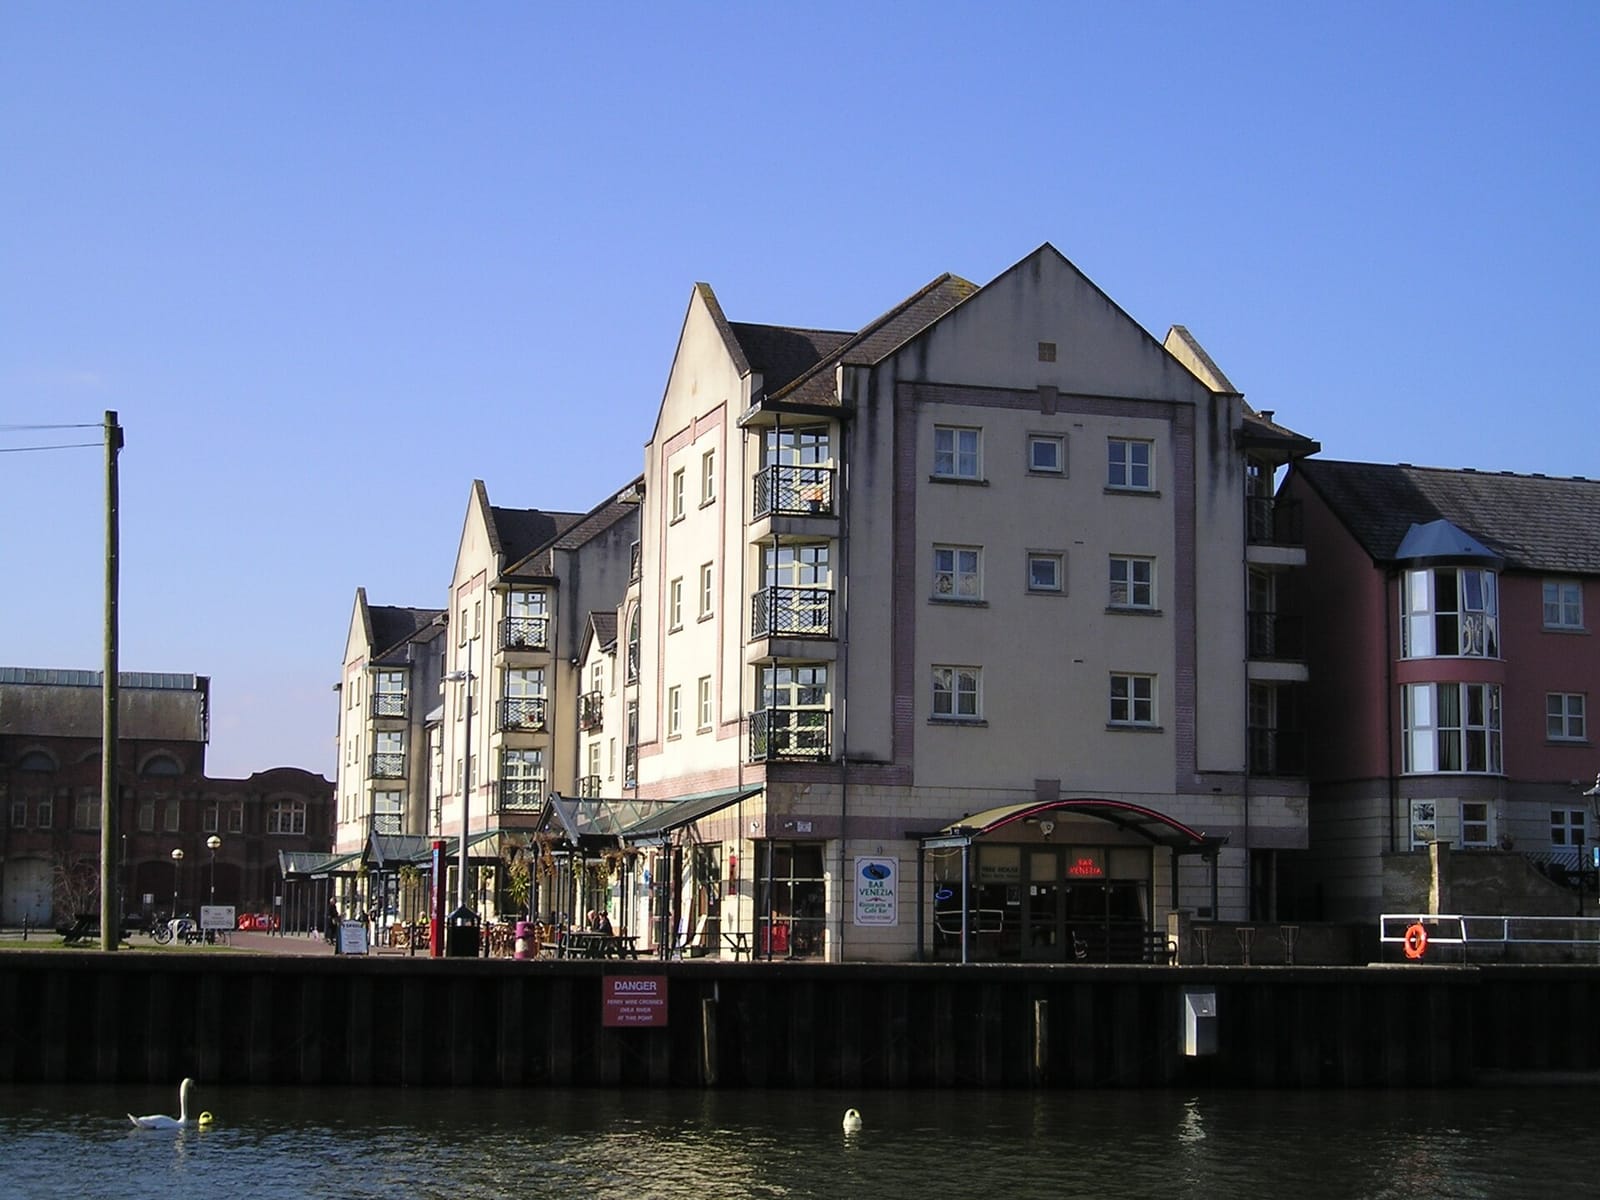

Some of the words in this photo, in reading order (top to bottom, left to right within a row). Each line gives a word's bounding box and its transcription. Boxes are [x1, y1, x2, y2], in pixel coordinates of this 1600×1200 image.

[1077, 858, 1093, 866] BAR
[1068, 865, 1102, 875] VENEZIA
[859, 888, 894, 897] VENEZIA
[614, 981, 657, 991] DANGER
